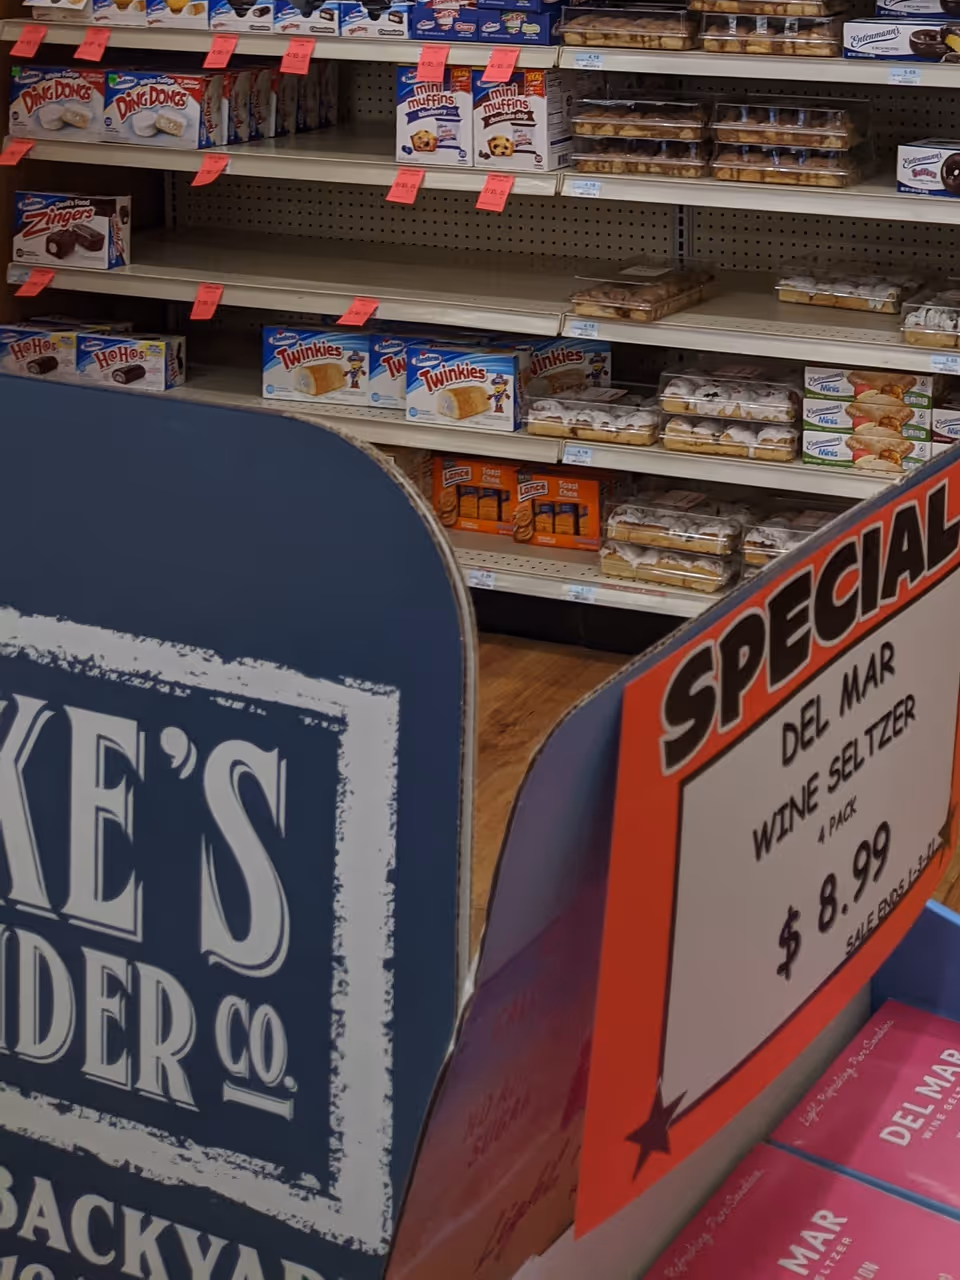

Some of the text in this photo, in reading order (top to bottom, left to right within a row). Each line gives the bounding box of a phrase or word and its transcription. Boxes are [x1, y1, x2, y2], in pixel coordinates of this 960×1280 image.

[850, 27, 902, 48] Entenmann's
[54, 79, 92, 102] DONGS
[116, 85, 188, 122] DING DONGS
[408, 94, 455, 109] muffins
[415, 83, 442, 96] mini
[490, 84, 517, 100] mini
[483, 99, 529, 114] muffins
[23, 207, 93, 238] Zingers
[276, 341, 342, 371] Twinkies
[419, 364, 487, 392] Twinkies
[444, 468, 470, 483] Lance
[521, 481, 547, 498] Lance
[782, 641, 895, 768] DEL MAR
[753, 693, 916, 862] WINE SELTZER
[817, 795, 857, 845] 4 PACK
[776, 820, 891, 980] $ 8.99
[846, 879, 905, 956] SALE ENDS
[879, 1102, 935, 1146] DEL
[922, 1112, 943, 1141] WINE
[778, 1209, 848, 1276] MAR
